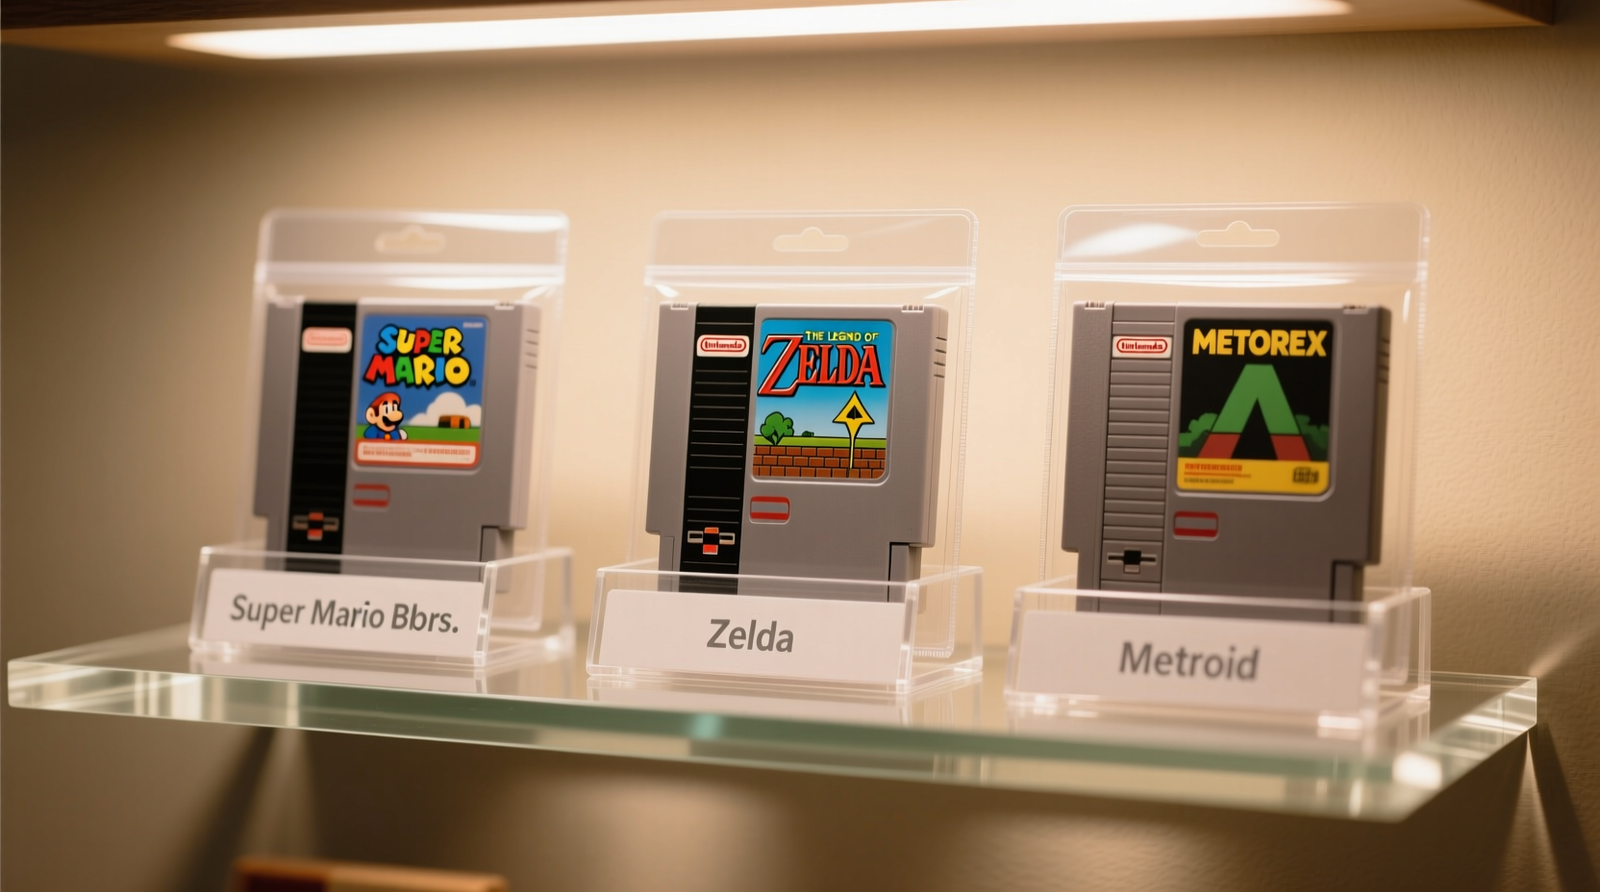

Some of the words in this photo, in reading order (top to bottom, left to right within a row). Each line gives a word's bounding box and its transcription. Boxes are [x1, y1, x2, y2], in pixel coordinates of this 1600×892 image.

[376, 323, 464, 355] SUPER
[805, 330, 825, 342] THE
[864, 332, 880, 343] OF
[1192, 328, 1328, 357] METOREX
[363, 353, 472, 389] MARIO
[756, 333, 887, 397] ZELDA
[230, 594, 306, 631] Super
[310, 599, 386, 629] Mario
[390, 602, 460, 634] Bbrs.
[706, 618, 794, 653] Zelda
[1118, 640, 1261, 681] Metroid
